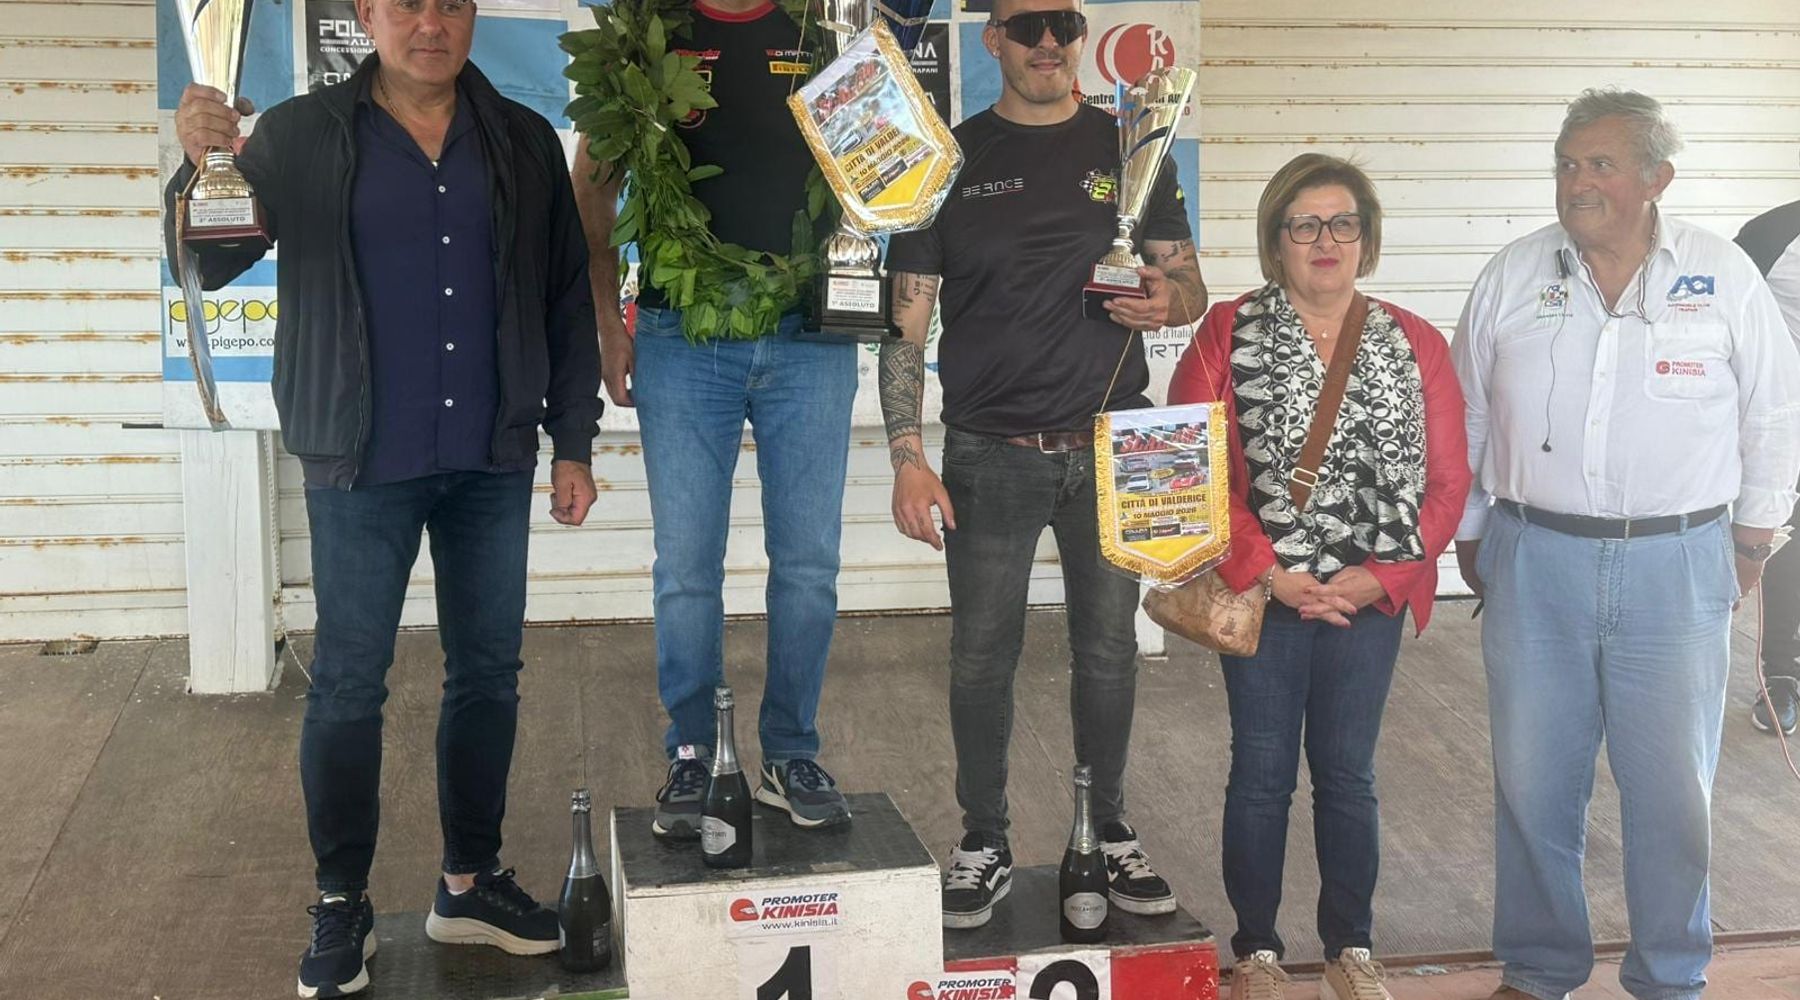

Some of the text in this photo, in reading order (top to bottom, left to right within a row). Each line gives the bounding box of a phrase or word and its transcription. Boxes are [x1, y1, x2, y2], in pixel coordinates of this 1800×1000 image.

[319, 19, 367, 38] POL
[350, 38, 377, 46] AUT
[319, 46, 377, 54] CONCESSIONA
[913, 42, 938, 58] NA
[1669, 275, 1715, 296] ACI
[169, 299, 278, 335] pgep
[176, 336, 277, 350] wpigepo.co
[1148, 497, 1158, 507] DI
[1160, 493, 1207, 506] VALDERICE
[1143, 510, 1174, 519] MAGGIO
[761, 893, 838, 906] PROMOTER
[761, 902, 839, 920] KINISIA
[761, 918, 838, 930] www.kinisia.it
[938, 978, 1012, 990] PROMOTER
